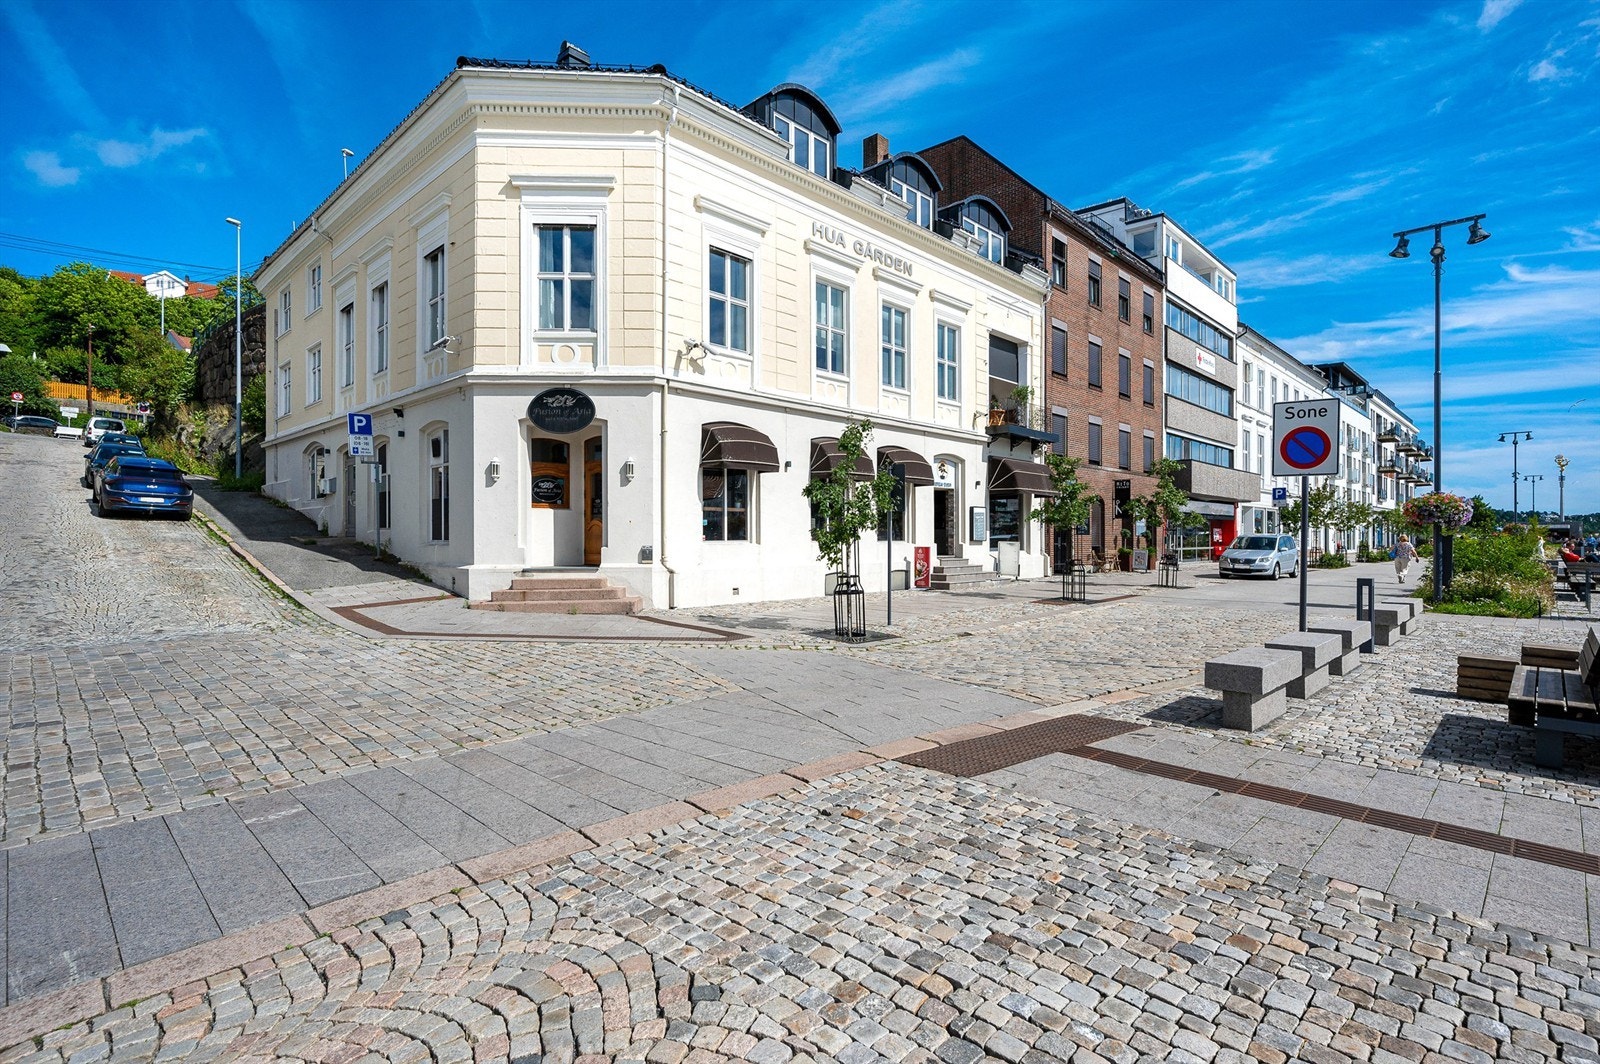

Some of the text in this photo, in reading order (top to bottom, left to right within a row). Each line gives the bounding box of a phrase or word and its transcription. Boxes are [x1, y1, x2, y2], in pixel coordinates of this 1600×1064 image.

[812, 221, 913, 276] HUA GÅRDEN
[531, 407, 561, 416] Fusion
[1284, 406, 1328, 420] Sone
[354, 415, 367, 432] P
[1275, 489, 1283, 499] P
